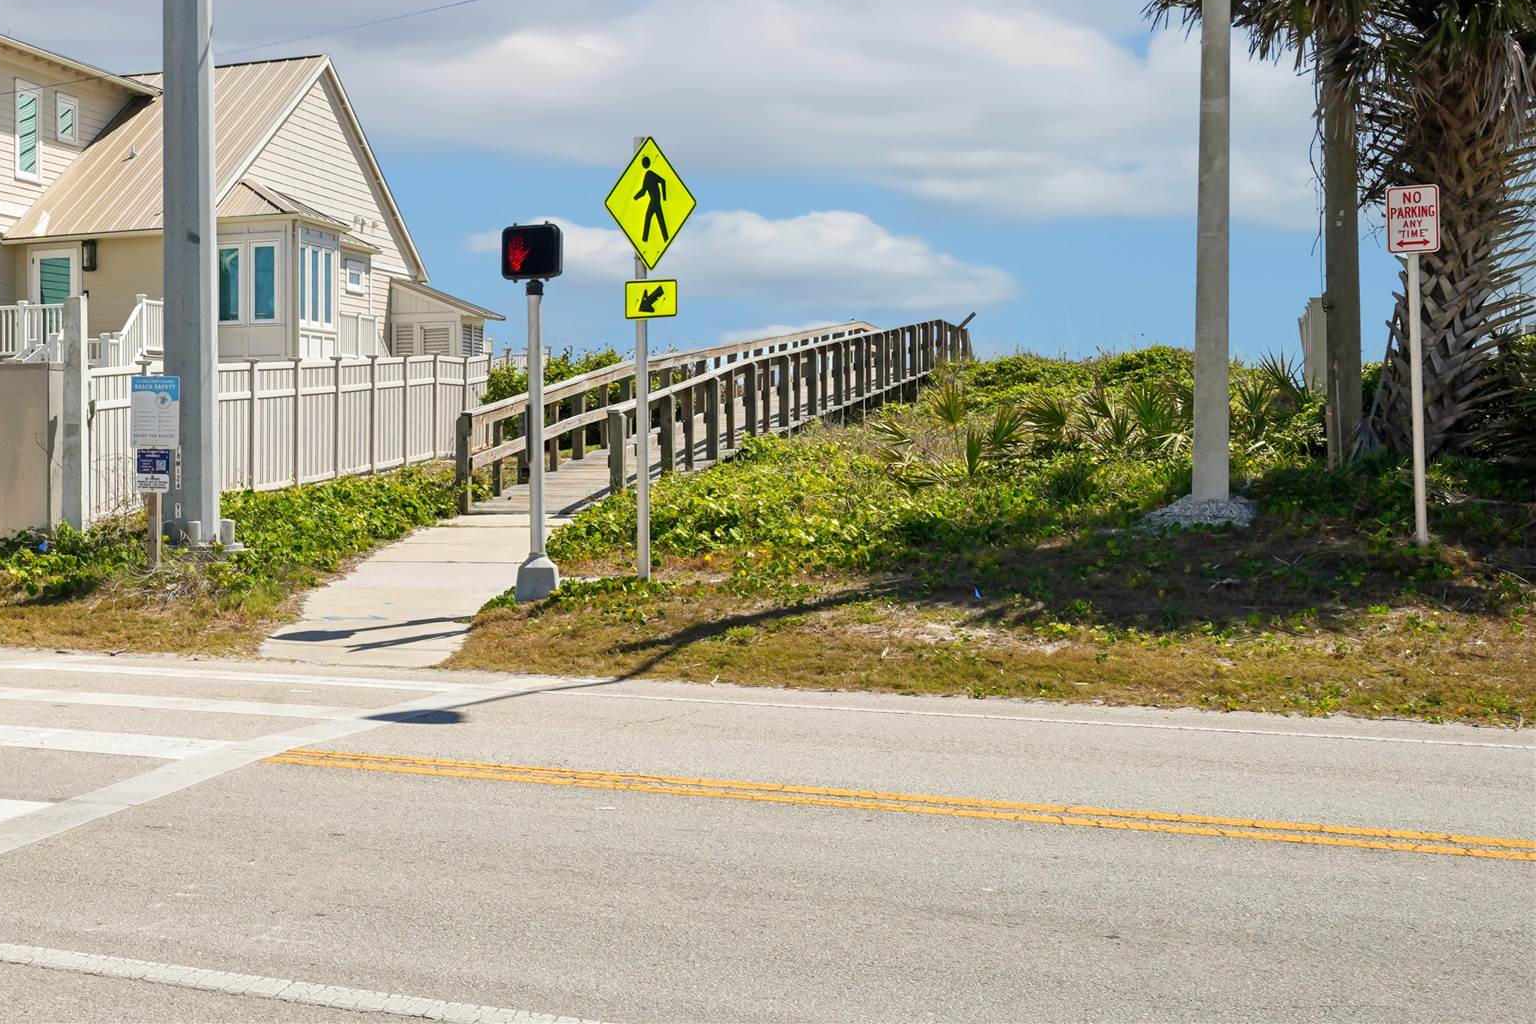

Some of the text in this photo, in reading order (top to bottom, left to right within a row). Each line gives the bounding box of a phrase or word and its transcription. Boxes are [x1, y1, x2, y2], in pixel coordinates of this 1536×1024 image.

[1402, 191, 1422, 204] NO
[1390, 205, 1435, 219] PARKING
[1402, 219, 1423, 229] ANY
